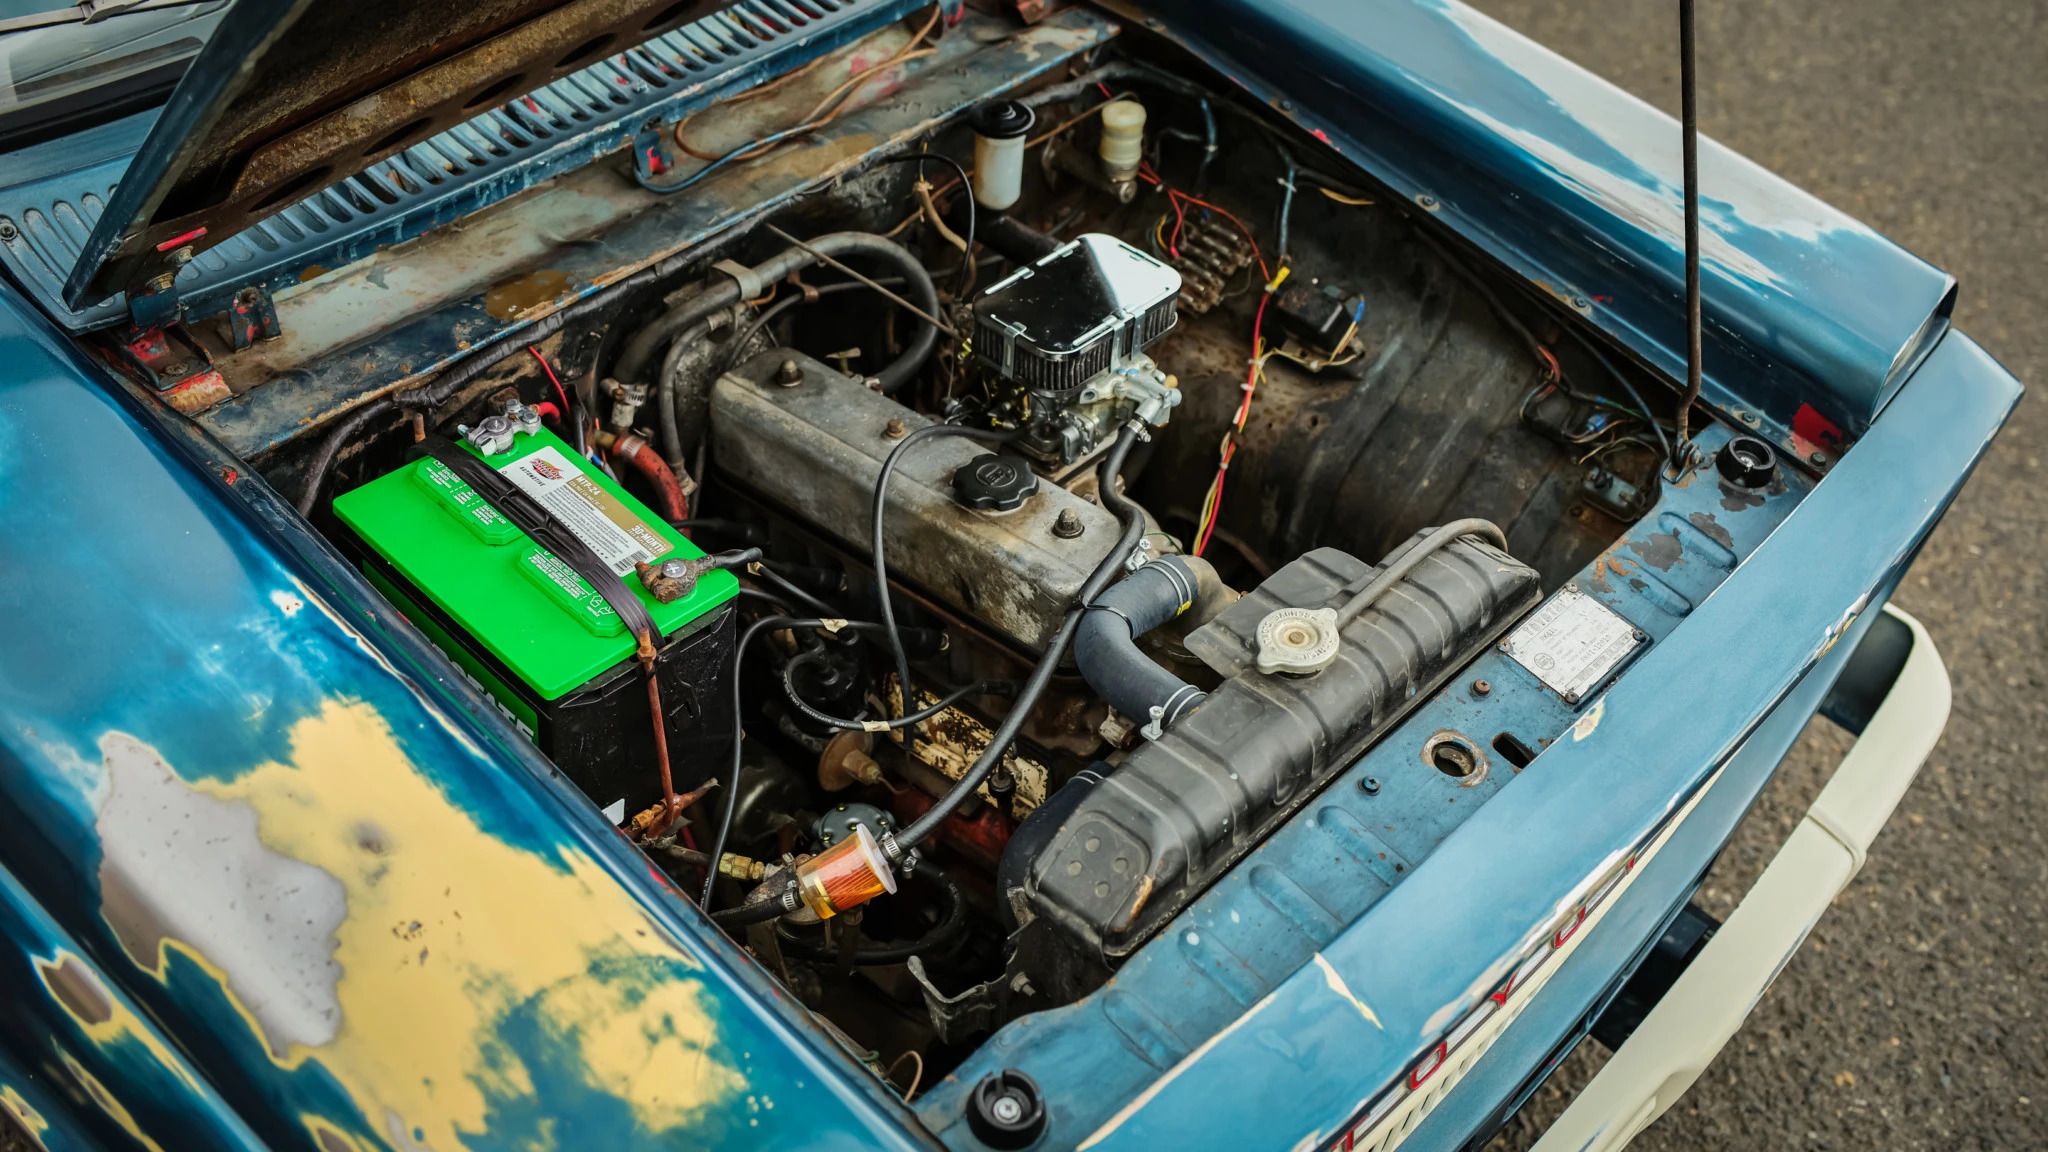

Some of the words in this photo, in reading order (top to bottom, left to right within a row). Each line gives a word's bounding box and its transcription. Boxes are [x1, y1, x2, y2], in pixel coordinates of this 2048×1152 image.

[519, 465, 545, 487] AUTOMOTIVE
[575, 475, 600, 495] MTP-24
[631, 525, 666, 553] 30-MONTH
[1328, 816, 1677, 1152] TOYO
